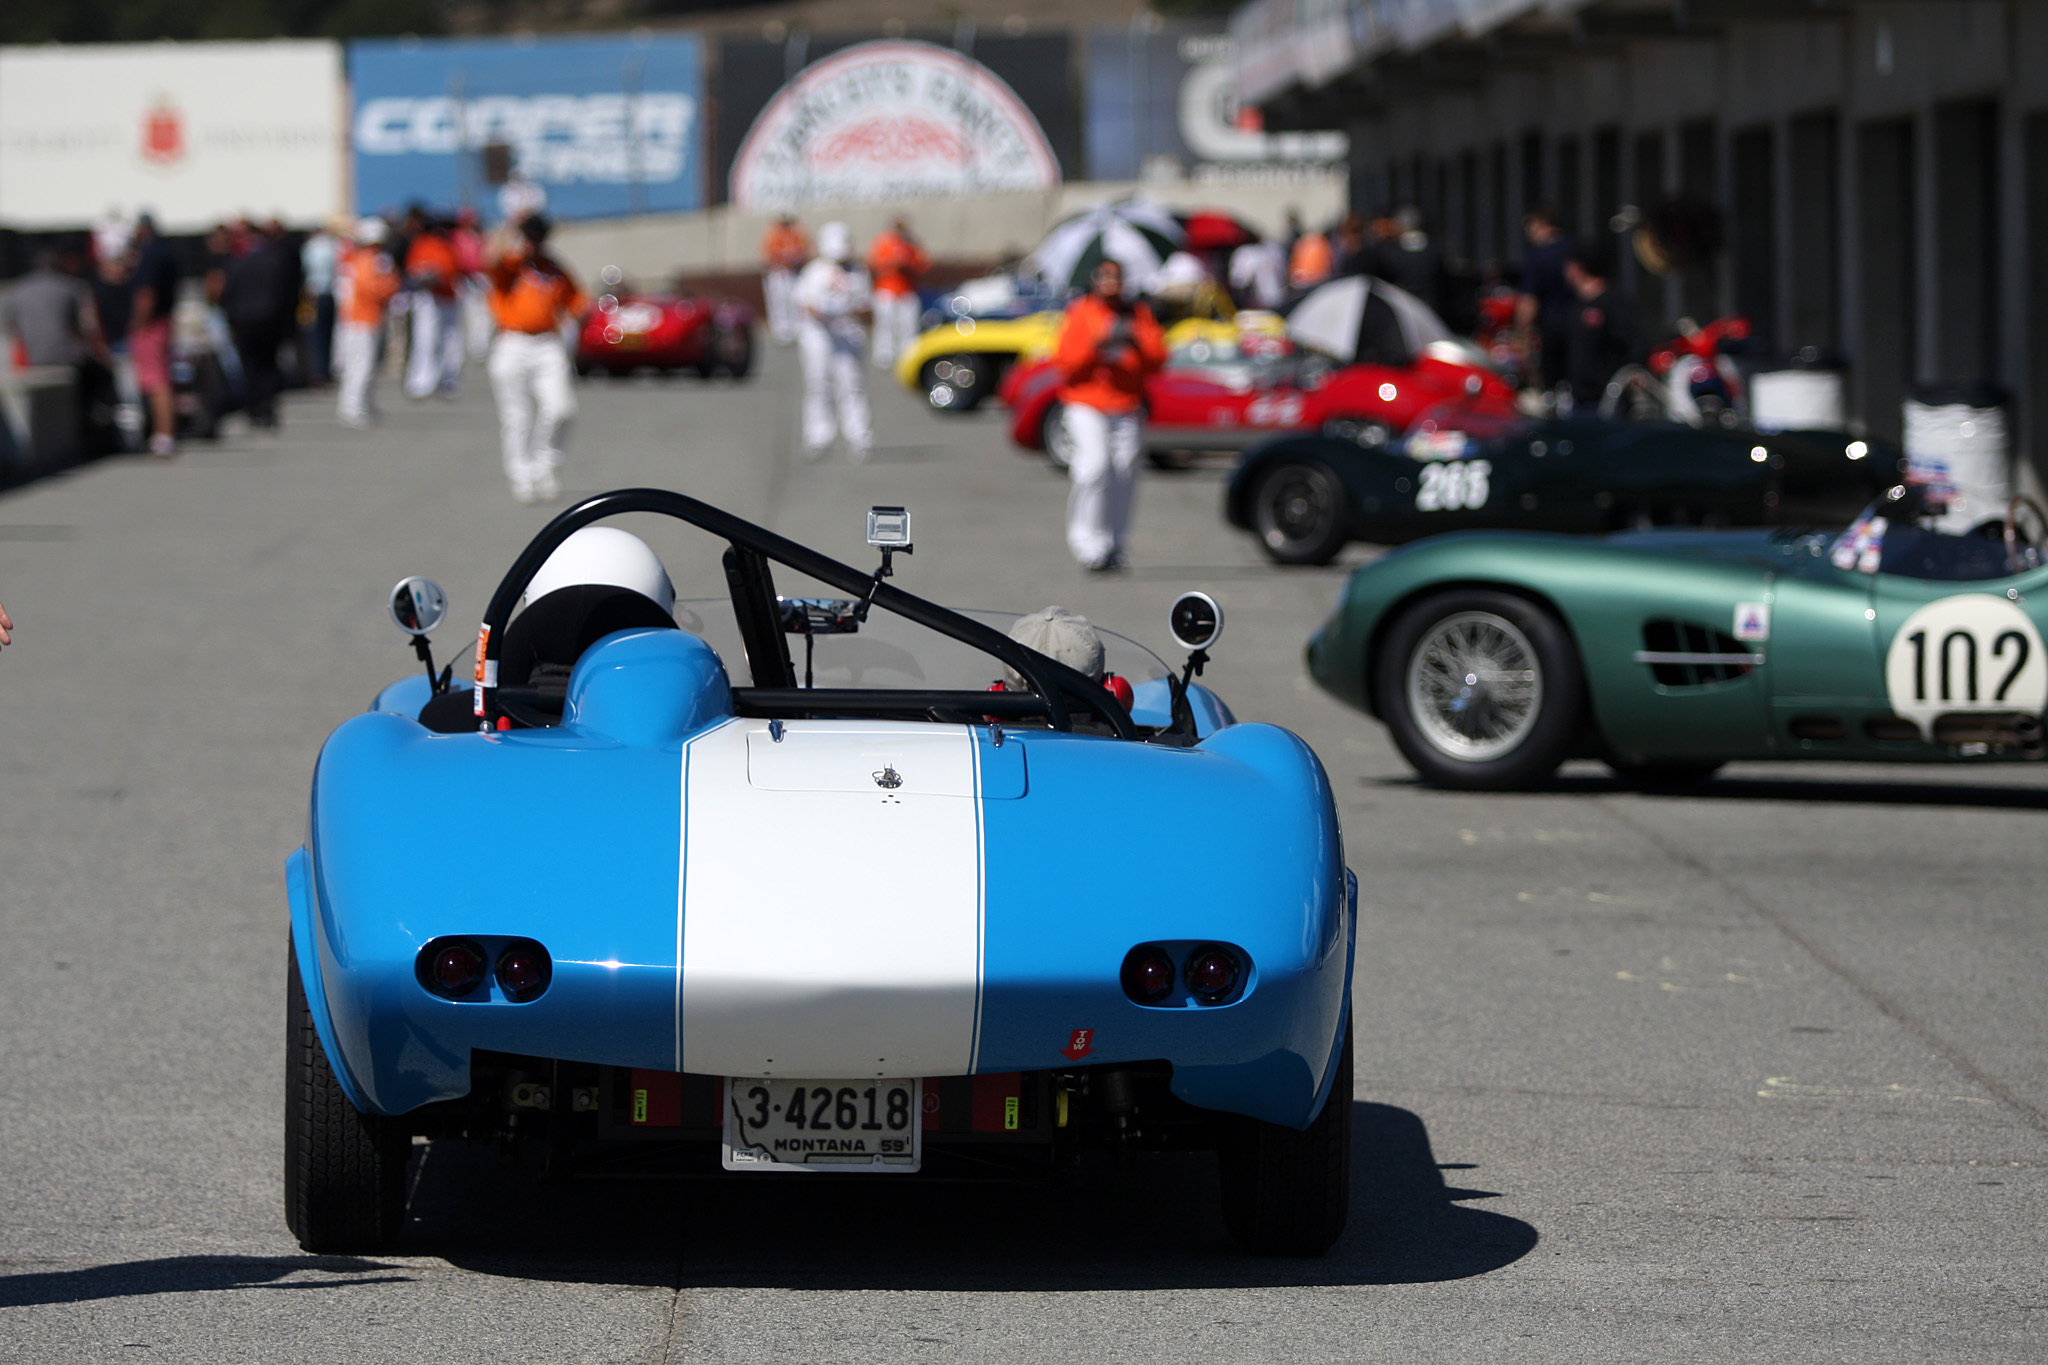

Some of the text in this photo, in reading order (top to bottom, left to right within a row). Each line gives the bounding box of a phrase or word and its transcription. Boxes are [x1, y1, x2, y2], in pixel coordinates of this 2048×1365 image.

[357, 95, 696, 155] COOPER
[1416, 459, 1492, 511] 265
[1907, 631, 2029, 701] 102
[1073, 1030, 1088, 1051] TOW
[774, 1138, 904, 1152] MONTANA 59
